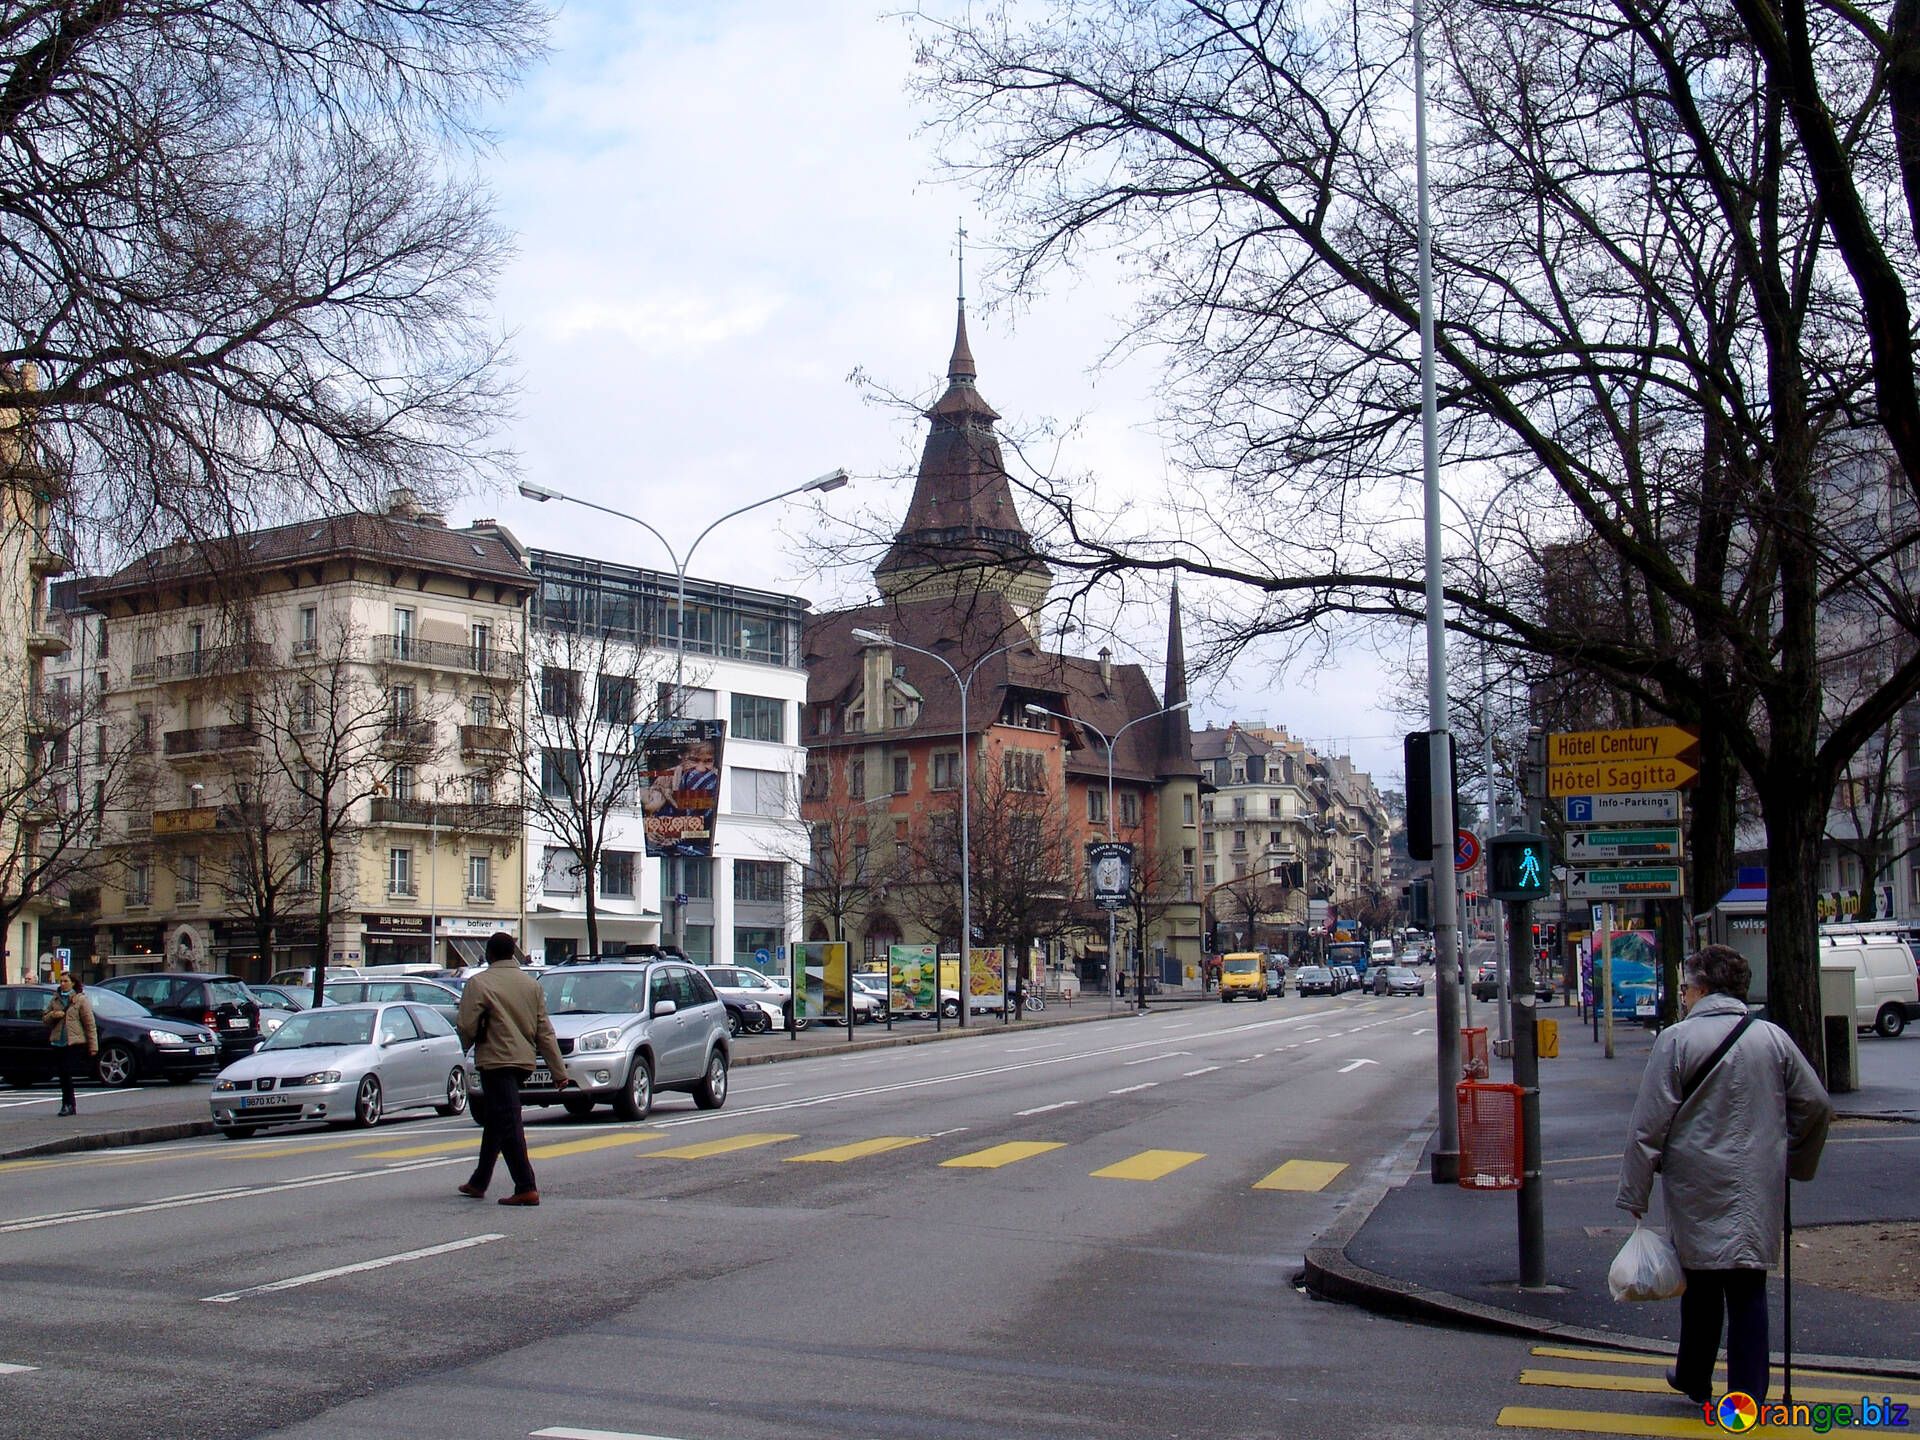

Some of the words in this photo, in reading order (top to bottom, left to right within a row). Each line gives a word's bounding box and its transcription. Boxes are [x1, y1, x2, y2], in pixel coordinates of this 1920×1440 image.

[1558, 736, 1596, 756] Hôtel
[1600, 734, 1659, 755] Century
[1551, 769, 1600, 791] Hôtel
[1607, 766, 1677, 790] Sagitta
[1575, 804, 1585, 819] P
[265, 1096, 276, 1105] XC
[277, 1095, 287, 1104] 74
